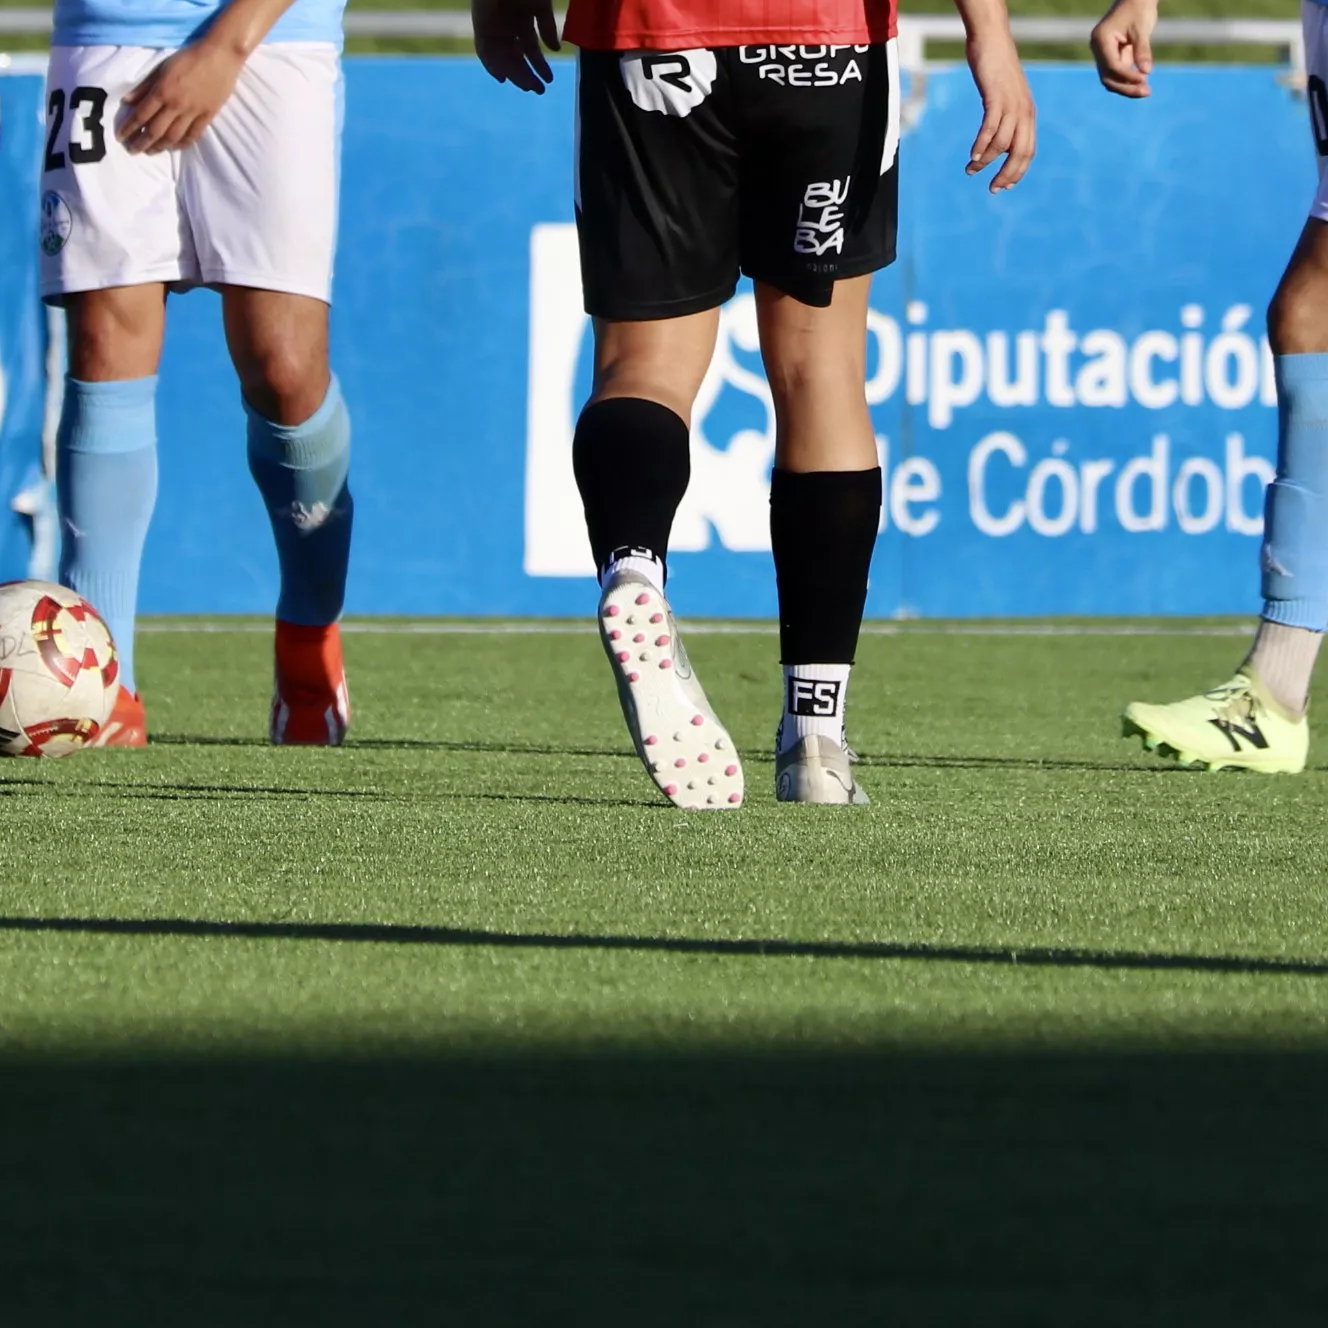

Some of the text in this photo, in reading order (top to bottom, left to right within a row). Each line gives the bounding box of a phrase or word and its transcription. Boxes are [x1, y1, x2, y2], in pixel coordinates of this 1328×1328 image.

[758, 59, 863, 87] RESA
[44, 86, 109, 172] 23
[792, 680, 836, 715] FS
